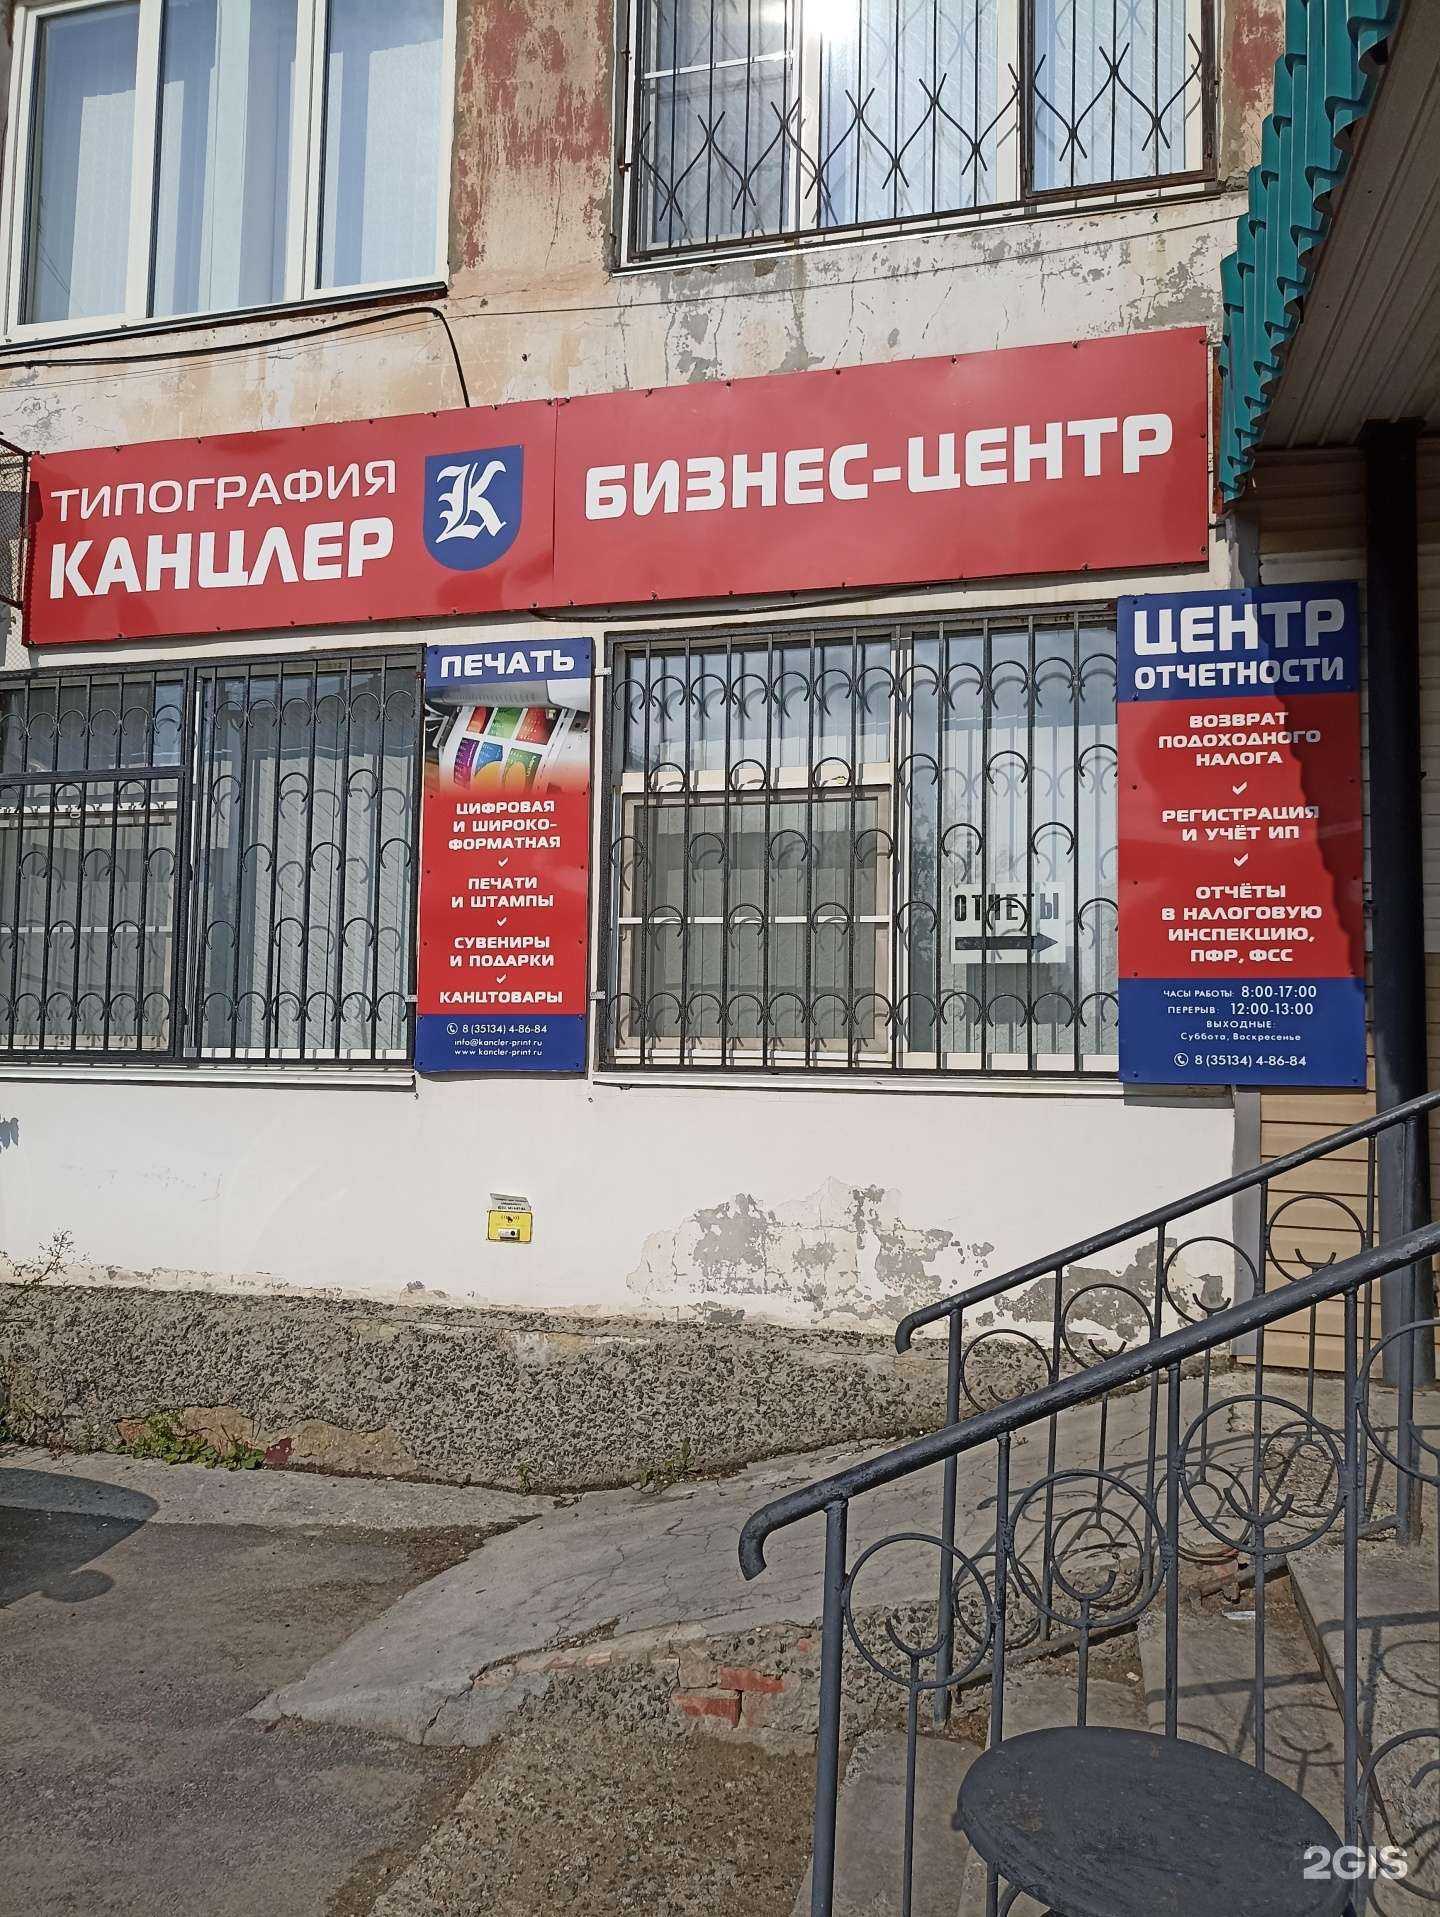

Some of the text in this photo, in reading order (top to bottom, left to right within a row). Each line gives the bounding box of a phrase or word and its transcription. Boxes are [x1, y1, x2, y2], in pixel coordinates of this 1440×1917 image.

[585, 413, 1173, 520] БИЗНЕС-ЦЕНТР
[51, 460, 396, 521] ТИПОГРАФИЯ
[50, 517, 393, 599] КАНЦЛЕР
[1134, 598, 1345, 656] ЦЕНТР
[440, 650, 575, 678] ПЕЧАТЬ
[1134, 656, 1344, 690] ОТЧЕТНОСТИ
[1189, 712, 1289, 728] ВОЗВРАТ
[1158, 730, 1321, 749] ПОДОХОДНОГО
[1196, 751, 1283, 767] НАЛОГА
[456, 800, 555, 815] ЦИФРОВАЯ
[1162, 806, 1319, 823] РЕГИСТРАЦИЯ
[453, 818, 557, 833] И ШИРОКО-
[1182, 825, 1300, 842] И УЧЁТ ИП
[448, 836, 561, 851] ФОРМАТНАЯ
[468, 876, 538, 890] ПЕЧАТИ
[1195, 883, 1286, 900] ОТЧЁТЫ
[451, 894, 554, 908] И ШТАМПЫ
[1161, 905, 1323, 921] В НАЛОГОВУЮ
[1168, 927, 1315, 942] ИНСПЕКЦИЮ,
[454, 936, 551, 949] СУВЕНИРЫ
[450, 954, 554, 967] И ПОДАРКИ
[1190, 948, 1294, 964] ПФР, ФСС
[439, 991, 563, 1004] КАНЦТОВАРЫ
[1163, 990, 1191, 998] ЧАСЫ
[1241, 985, 1317, 998] 8:00-17:00
[1230, 1003, 1314, 1015] 12:00-13:00
[462, 1025, 548, 1034] 8 (35134) 4-86-84
[454, 1038, 543, 1047] info@kancler-printru
[1233, 1033, 1301, 1042] Воскресенье
[454, 1048, 543, 1057] wwwkancler-printru
[1194, 1055, 1307, 1067] 8 (35134) 4-86-84
